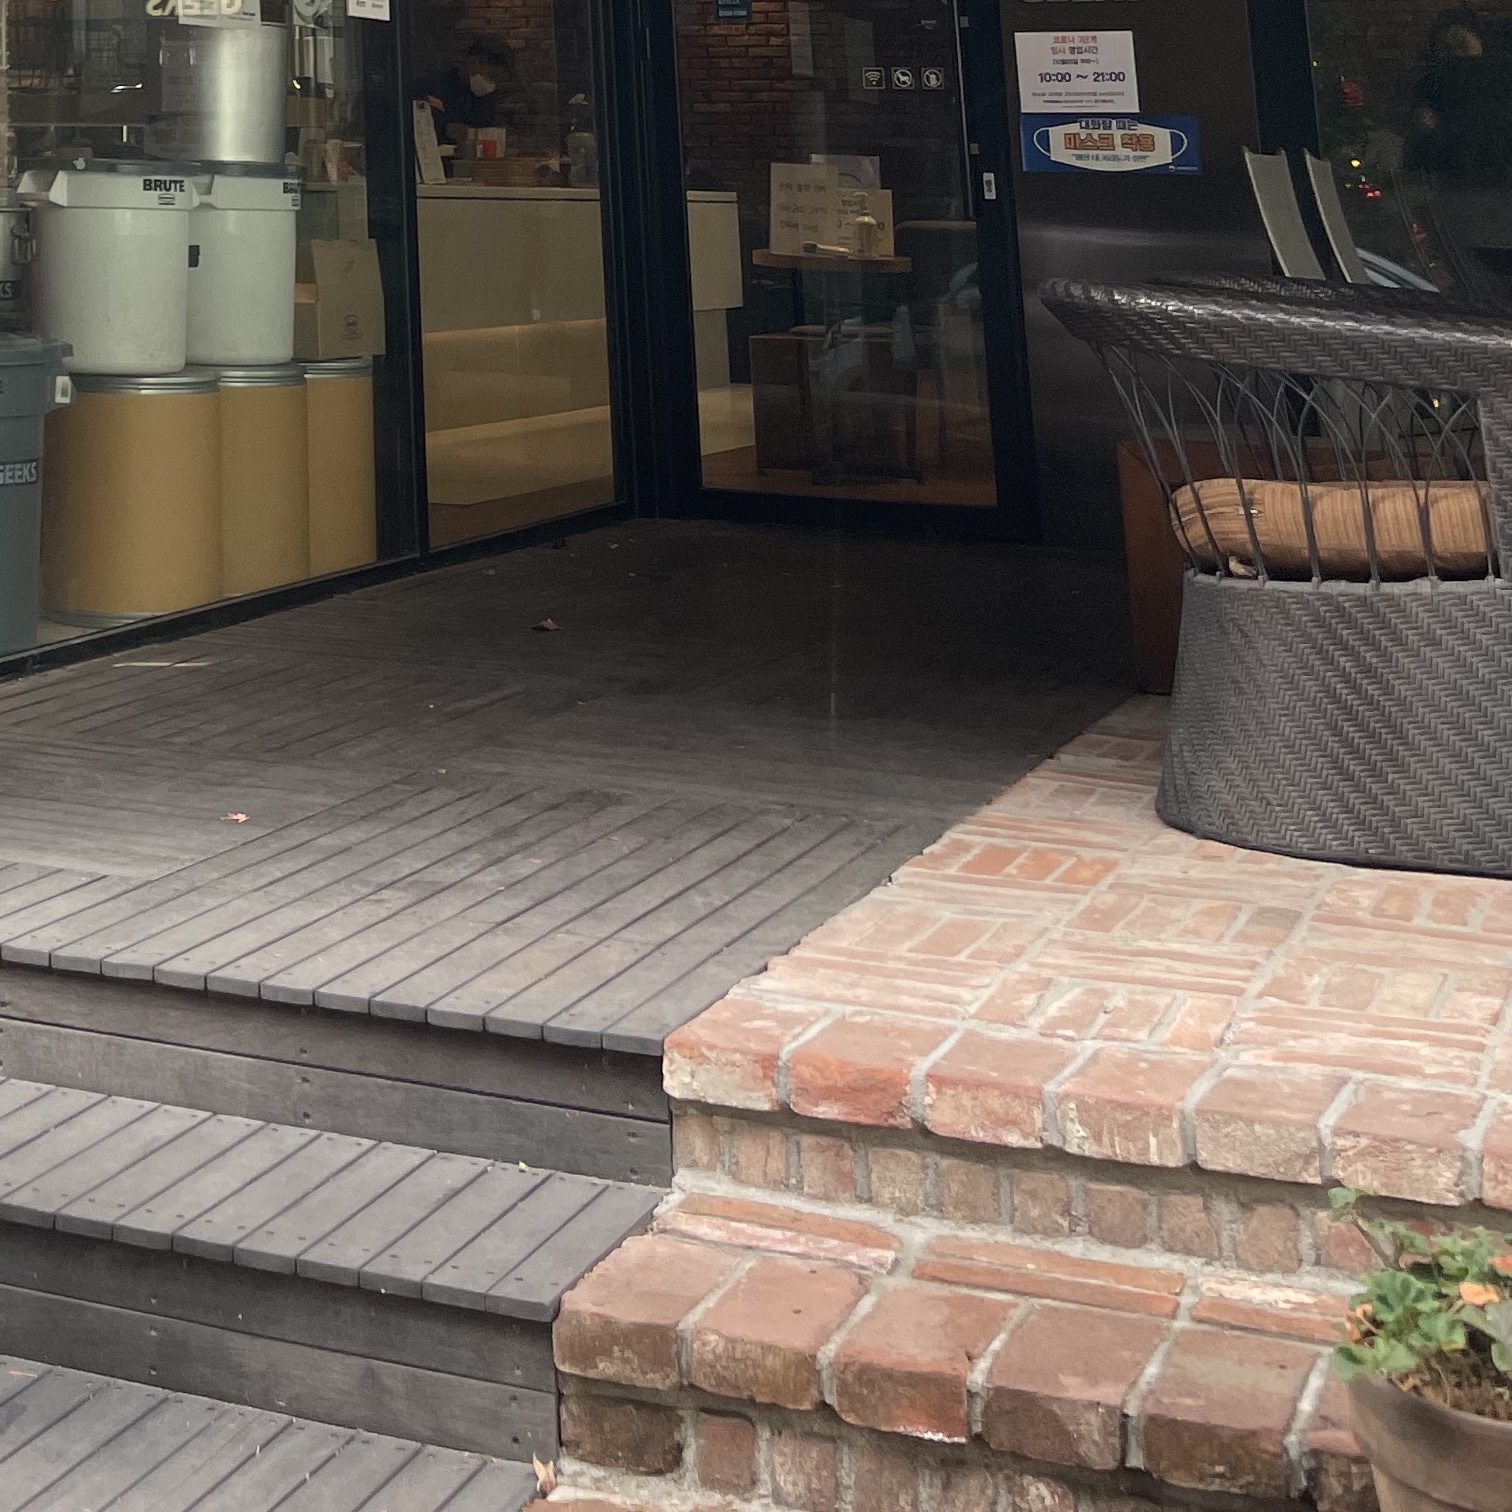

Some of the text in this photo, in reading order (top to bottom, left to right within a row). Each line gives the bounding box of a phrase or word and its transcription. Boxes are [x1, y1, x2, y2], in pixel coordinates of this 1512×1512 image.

[1038, 71, 1072, 83] 10:00
[1092, 71, 1126, 83] 21:00
[1064, 132, 1156, 152] 마스크 착용
[142, 178, 186, 193] BRUTE
